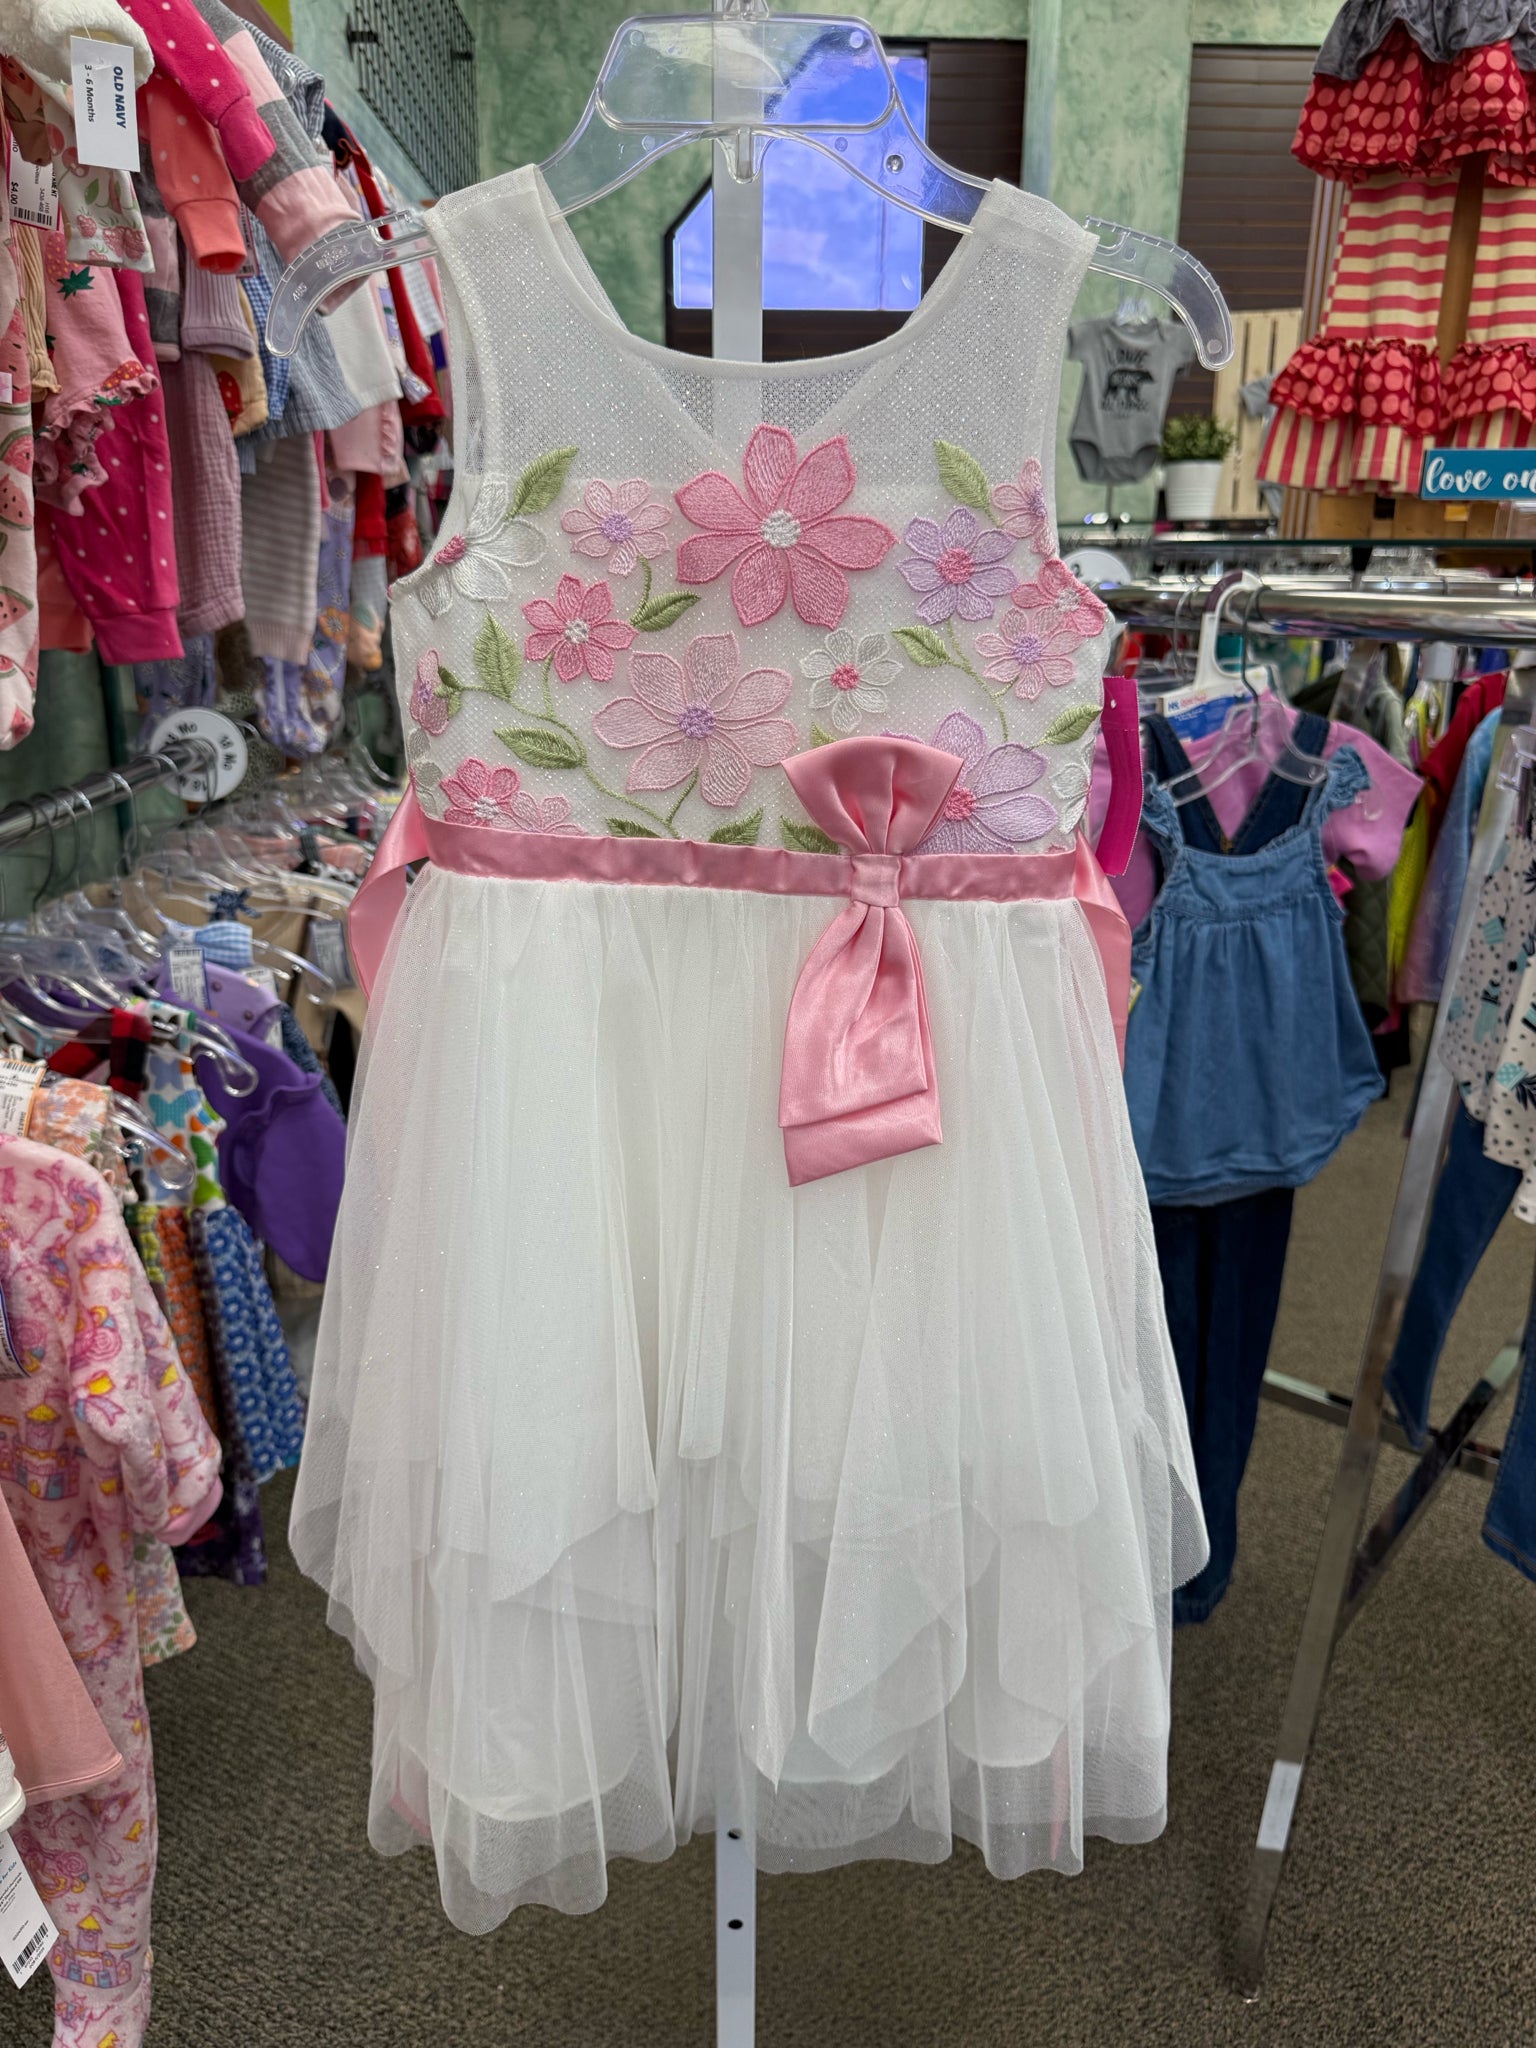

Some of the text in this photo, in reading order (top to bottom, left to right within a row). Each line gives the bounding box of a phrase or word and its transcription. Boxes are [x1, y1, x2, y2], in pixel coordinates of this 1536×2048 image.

[85, 86, 96, 123] Months
[113, 66, 127, 129] OLD NAVY
[10, 181, 19, 205] $4.00
[1425, 456, 1493, 494] love
[178, 722, 198, 734] Mo
[222, 753, 237, 772] Mo
[8, 1861, 17, 1873] Kids
